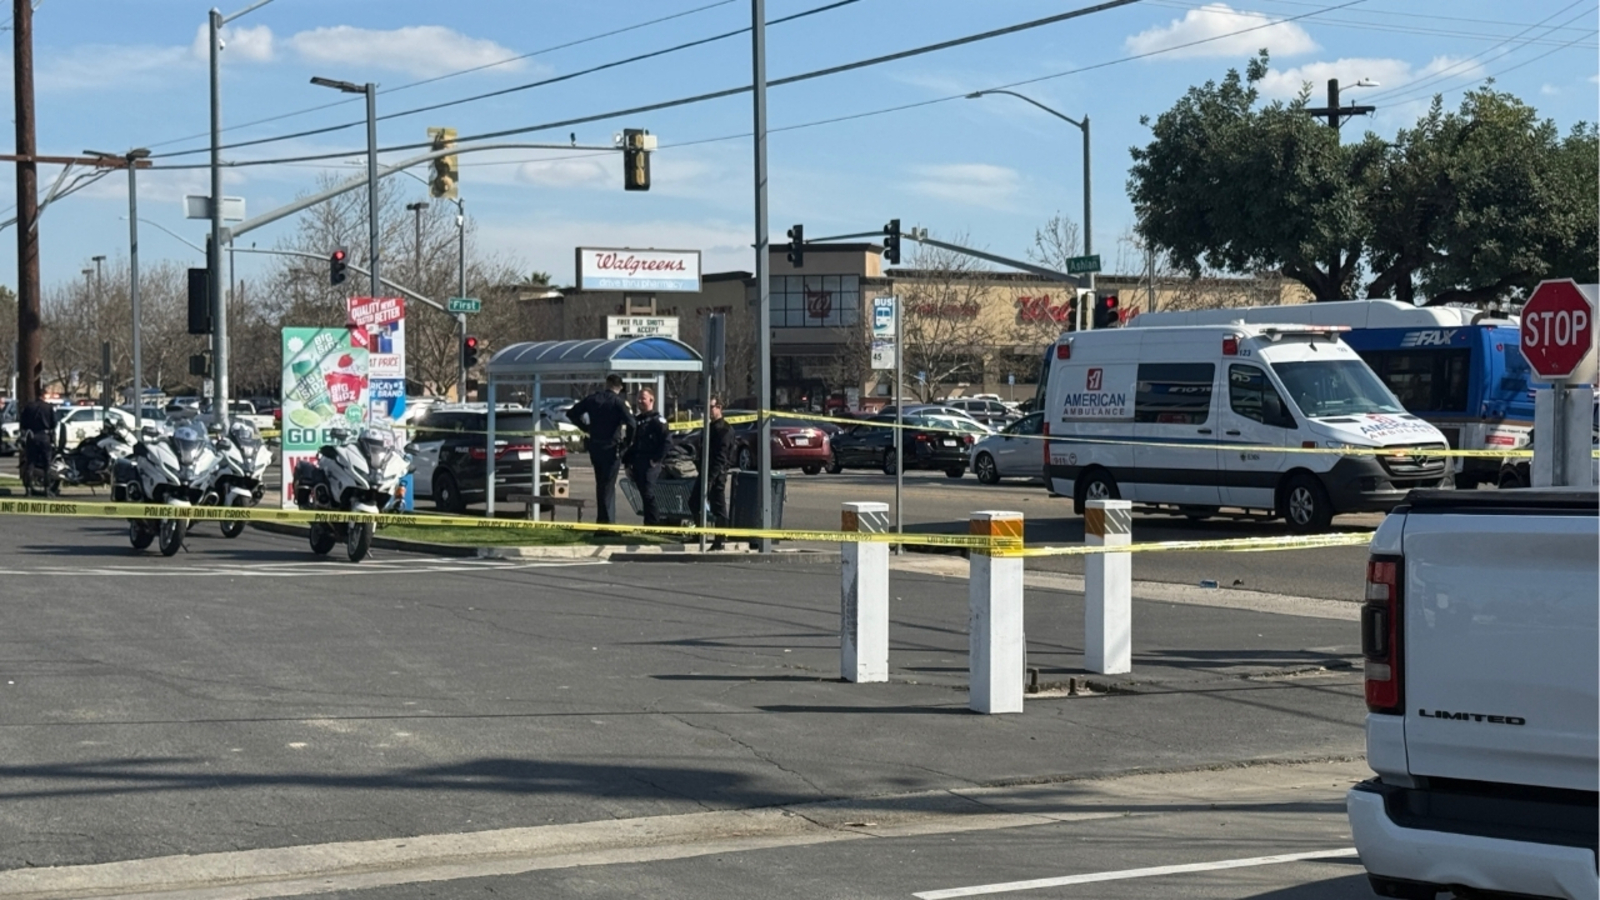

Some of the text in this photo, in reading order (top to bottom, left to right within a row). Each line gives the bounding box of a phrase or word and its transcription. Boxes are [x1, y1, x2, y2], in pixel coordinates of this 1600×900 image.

[595, 253, 686, 276] Walgreens
[600, 278, 683, 290] drive thru pharmacy
[453, 300, 476, 310] First
[874, 298, 893, 307] BUS
[351, 299, 396, 321] QUALITY NEVER
[374, 305, 400, 324] BETTER
[1524, 310, 1587, 348] STOP
[314, 332, 333, 346] BIG
[1415, 329, 1459, 346] FAX
[1239, 349, 1251, 357] 123
[378, 356, 399, 368] PRICE
[331, 383, 349, 394] BIG
[377, 390, 403, 398] BRAND
[332, 390, 356, 403] SIPZ
[1064, 393, 1126, 407] AMERICAN
[1063, 407, 1125, 416] AMBULANCE
[288, 428, 317, 444] GO
[0, 501, 77, 514] INE DO NOT CROSS
[144, 506, 251, 518] POLICE LINE DO NOT CROSS
[315, 513, 341, 523] POLICE
[343, 514, 360, 523] LINE
[362, 515, 373, 524] DO
[374, 516, 389, 524] NOT
[1419, 708, 1526, 726] LIMITED
